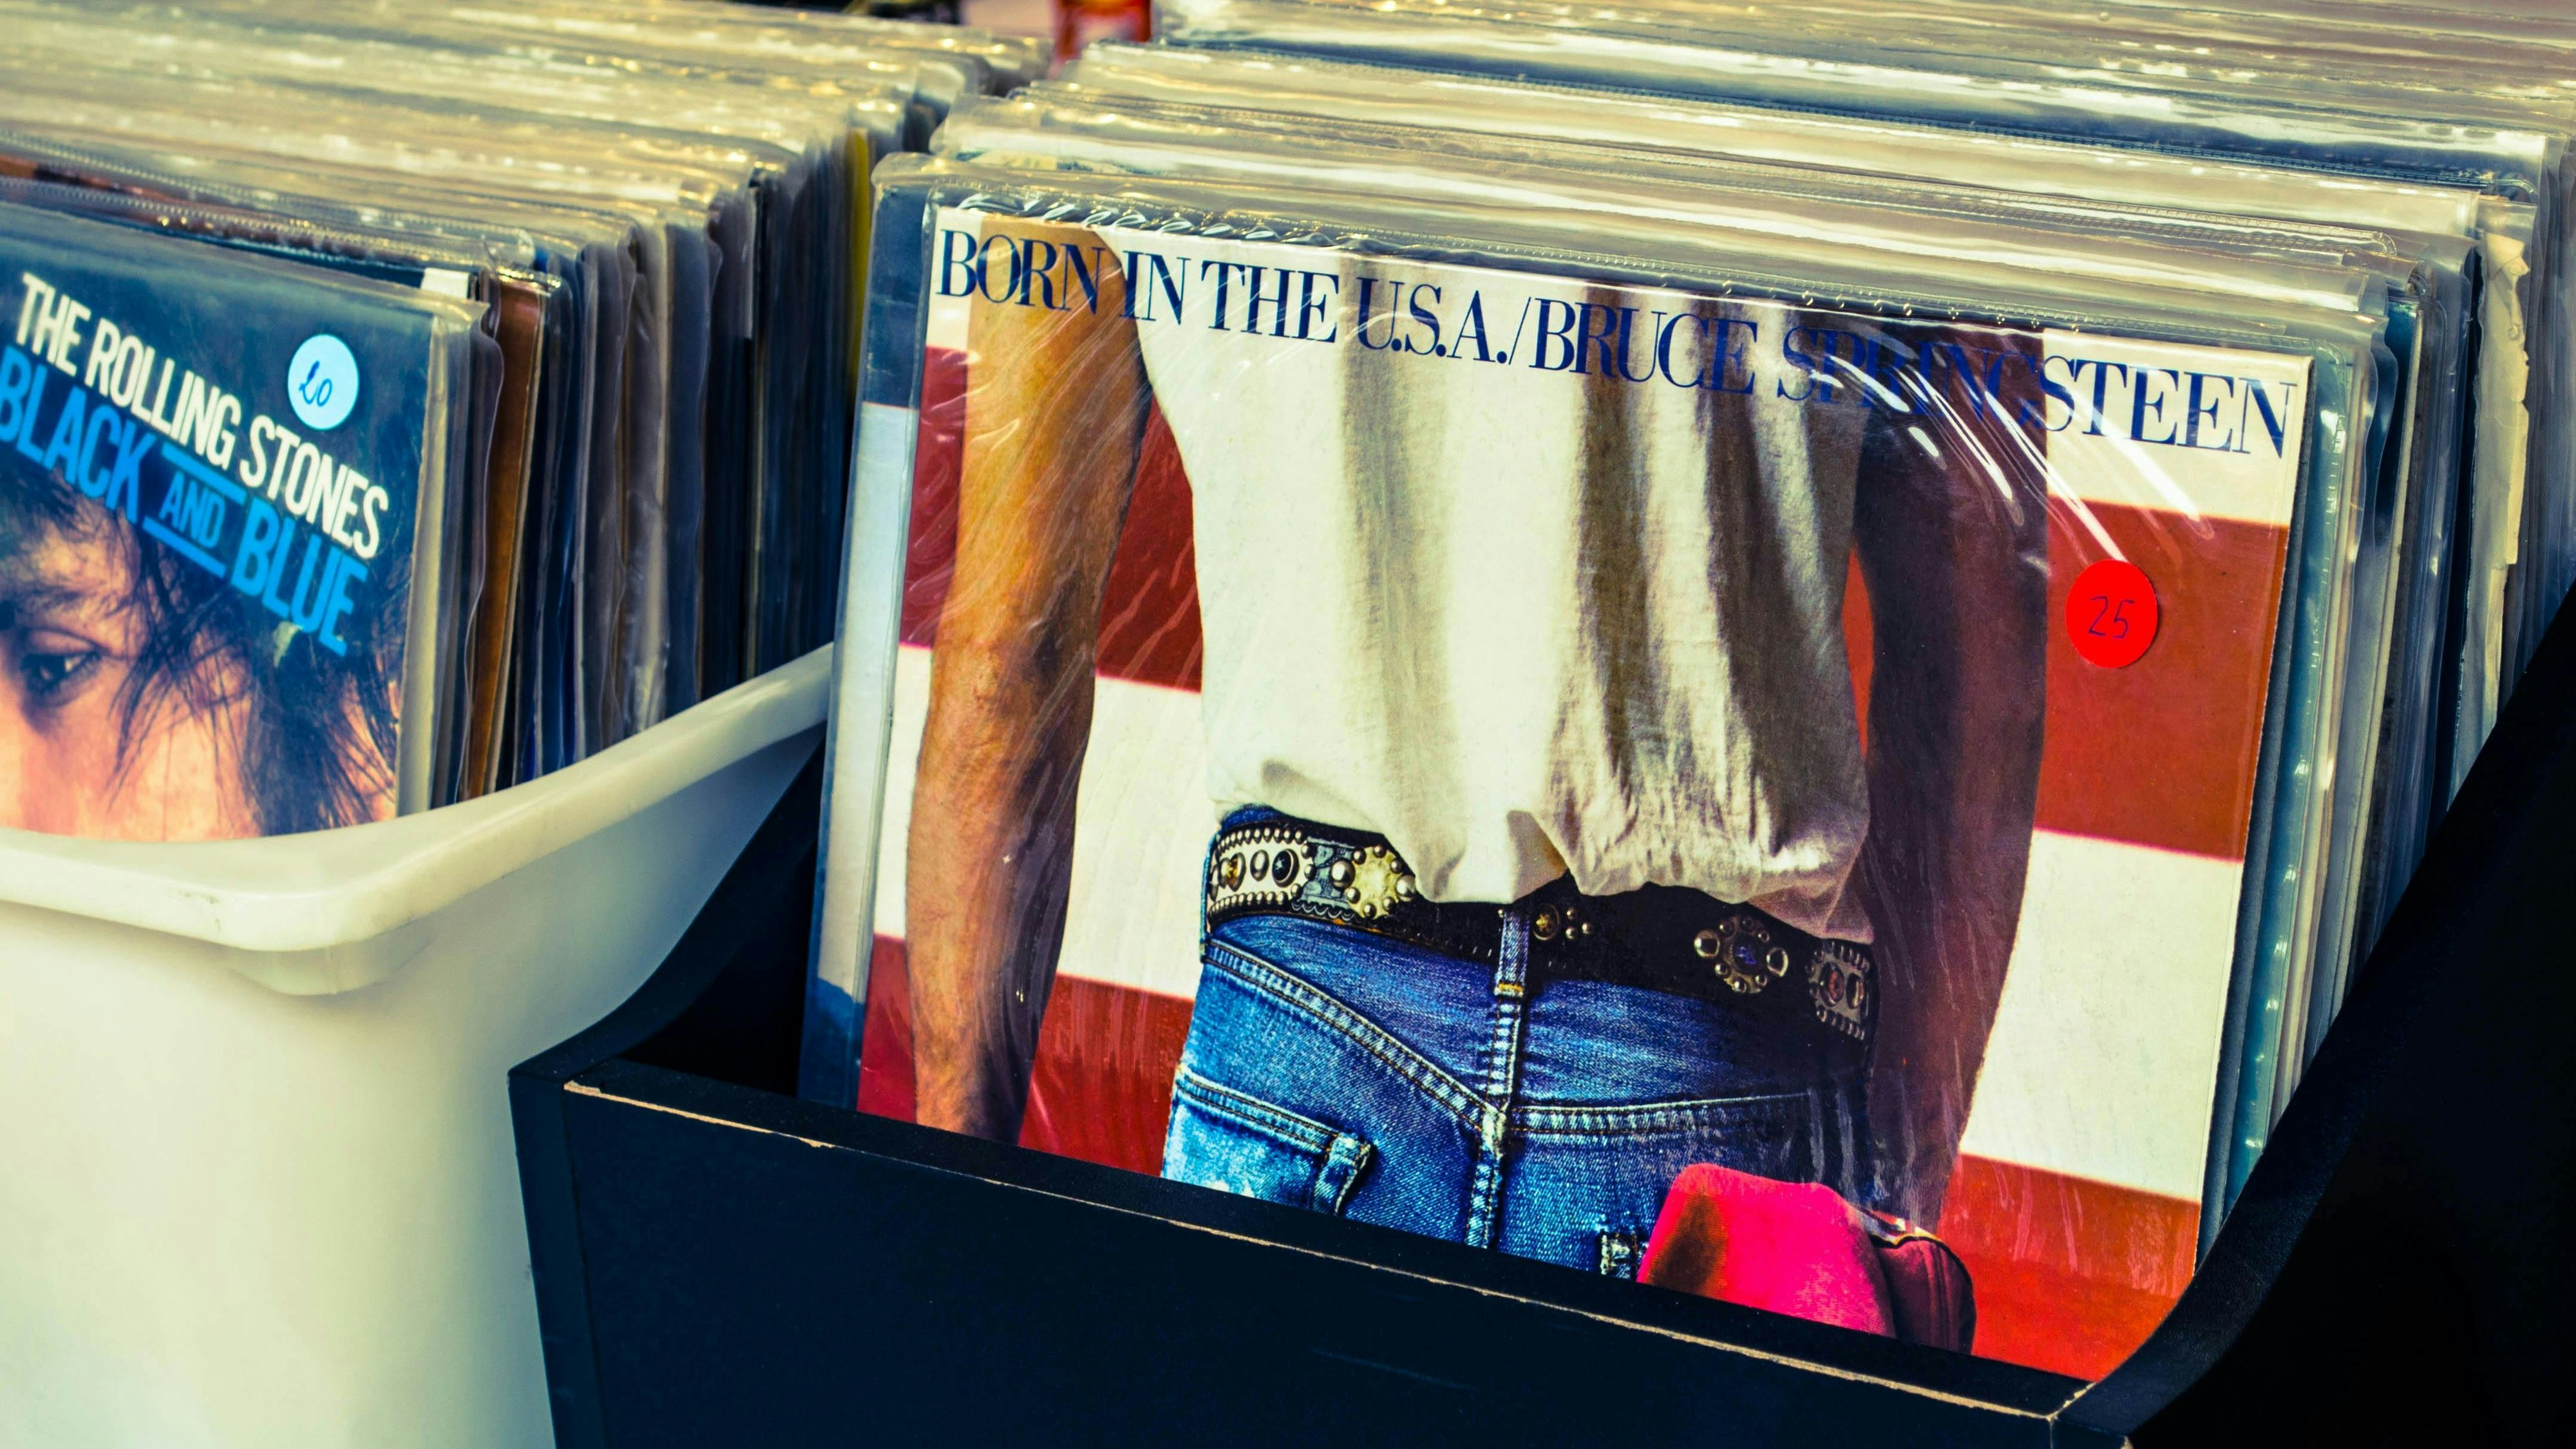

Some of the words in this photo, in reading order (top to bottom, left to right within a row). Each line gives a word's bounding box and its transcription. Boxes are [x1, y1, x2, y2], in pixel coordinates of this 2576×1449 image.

[936, 229, 1106, 314] BORN
[1119, 250, 1192, 325] IN
[1201, 260, 1340, 343] THE
[0, 345, 157, 524] BLACK
[159, 471, 226, 549] AND
[231, 497, 368, 657] BLUE
[16, 272, 91, 376] THE
[85, 318, 242, 469] ROLLING
[240, 415, 388, 559] STONES
[2088, 595, 2136, 639] 25
